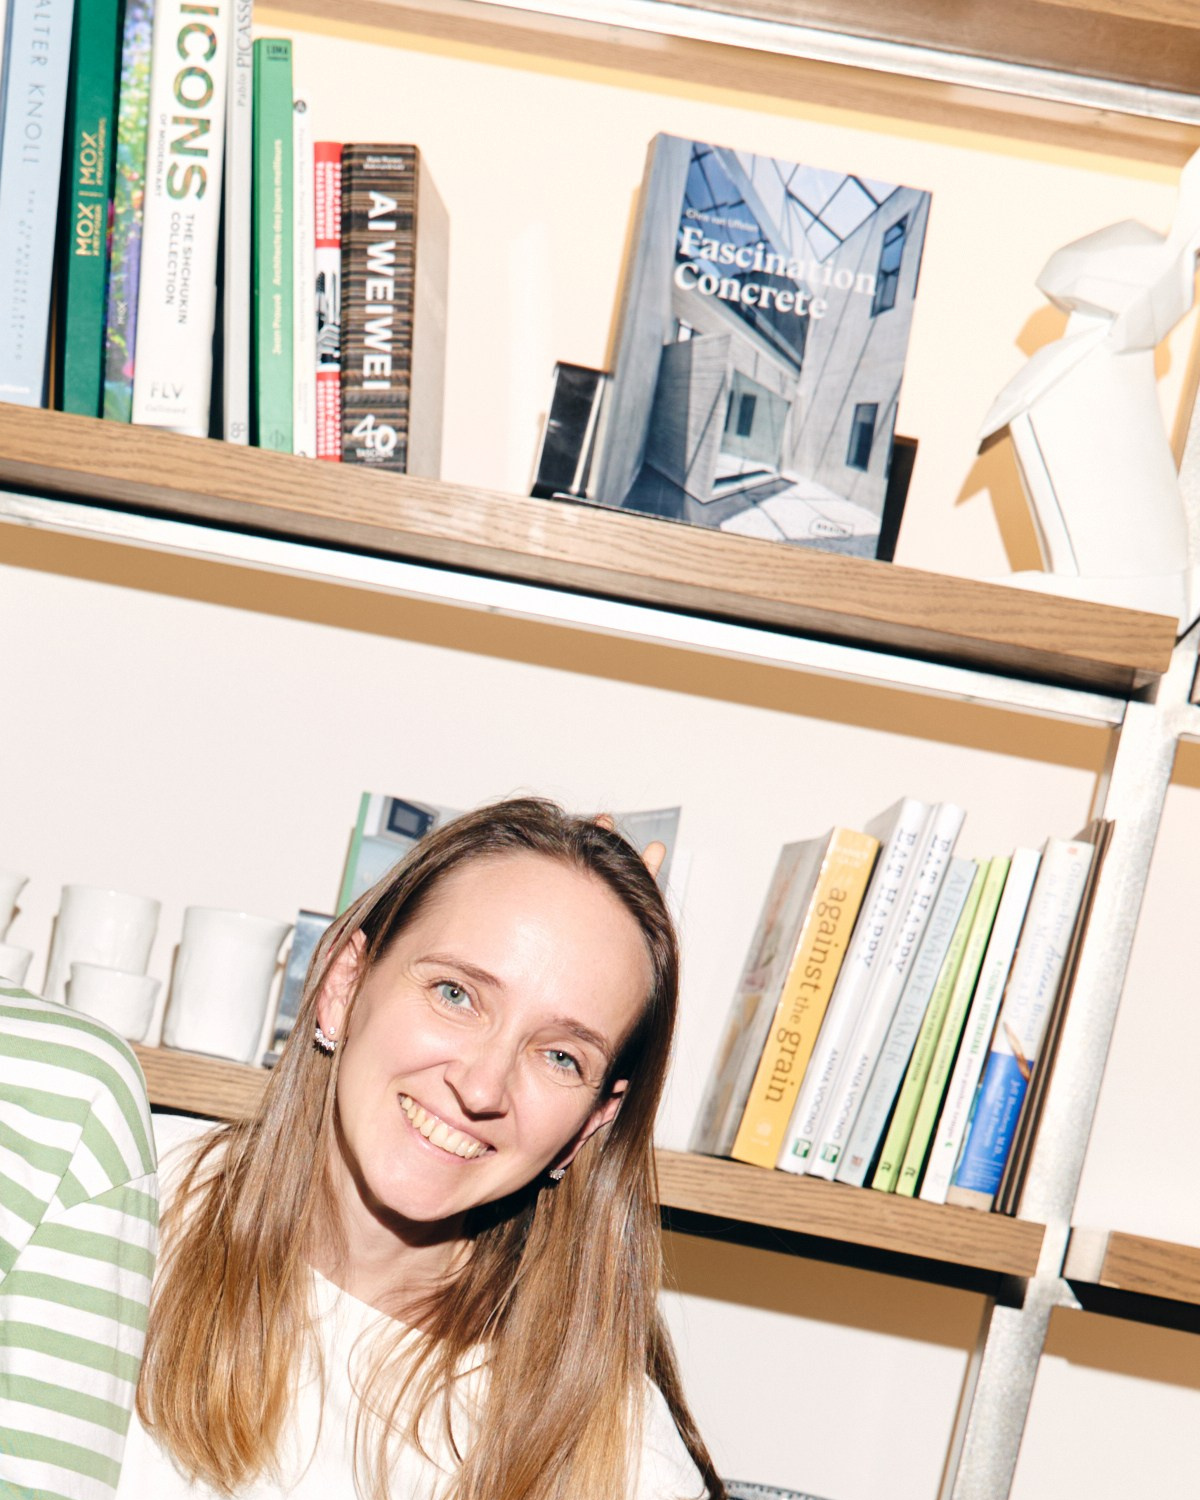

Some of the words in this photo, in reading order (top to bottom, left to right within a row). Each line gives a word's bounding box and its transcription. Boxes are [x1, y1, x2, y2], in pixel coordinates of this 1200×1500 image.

[237, 0, 252, 69] PICASS
[22, 83, 47, 164] KNOLL
[166, 3, 219, 200] ICONS
[79, 131, 98, 186] MOX
[155, 130, 166, 175] MODERN
[154, 178, 162, 197] ART
[367, 191, 397, 230] AI
[75, 201, 95, 256] MOX
[183, 213, 195, 242] THE
[165, 211, 180, 306] COLLECTION
[178, 246, 193, 325] SHCHUKIN
[678, 226, 876, 297] Fascination
[362, 239, 396, 390] WEIWEI
[674, 261, 828, 320] Concrete
[150, 381, 184, 400] FLV
[352, 414, 397, 452] 40
[887, 828, 917, 879] EAT
[919, 834, 952, 885] EAT
[800, 887, 847, 994] against
[856, 883, 898, 968] HAPPY
[887, 889, 931, 974] HAPPY
[909, 872, 966, 999] ALTERNATIVE
[790, 996, 809, 1026] the
[885, 1004, 920, 1064] BAKER
[1024, 1002, 1044, 1043] Bread
[764, 1027, 802, 1104] grain
[821, 1048, 839, 1082] ANNA
[850, 1054, 869, 1088] ANNA
[803, 1085, 827, 1135] VOCINO
[833, 1090, 856, 1140] VOCINO
